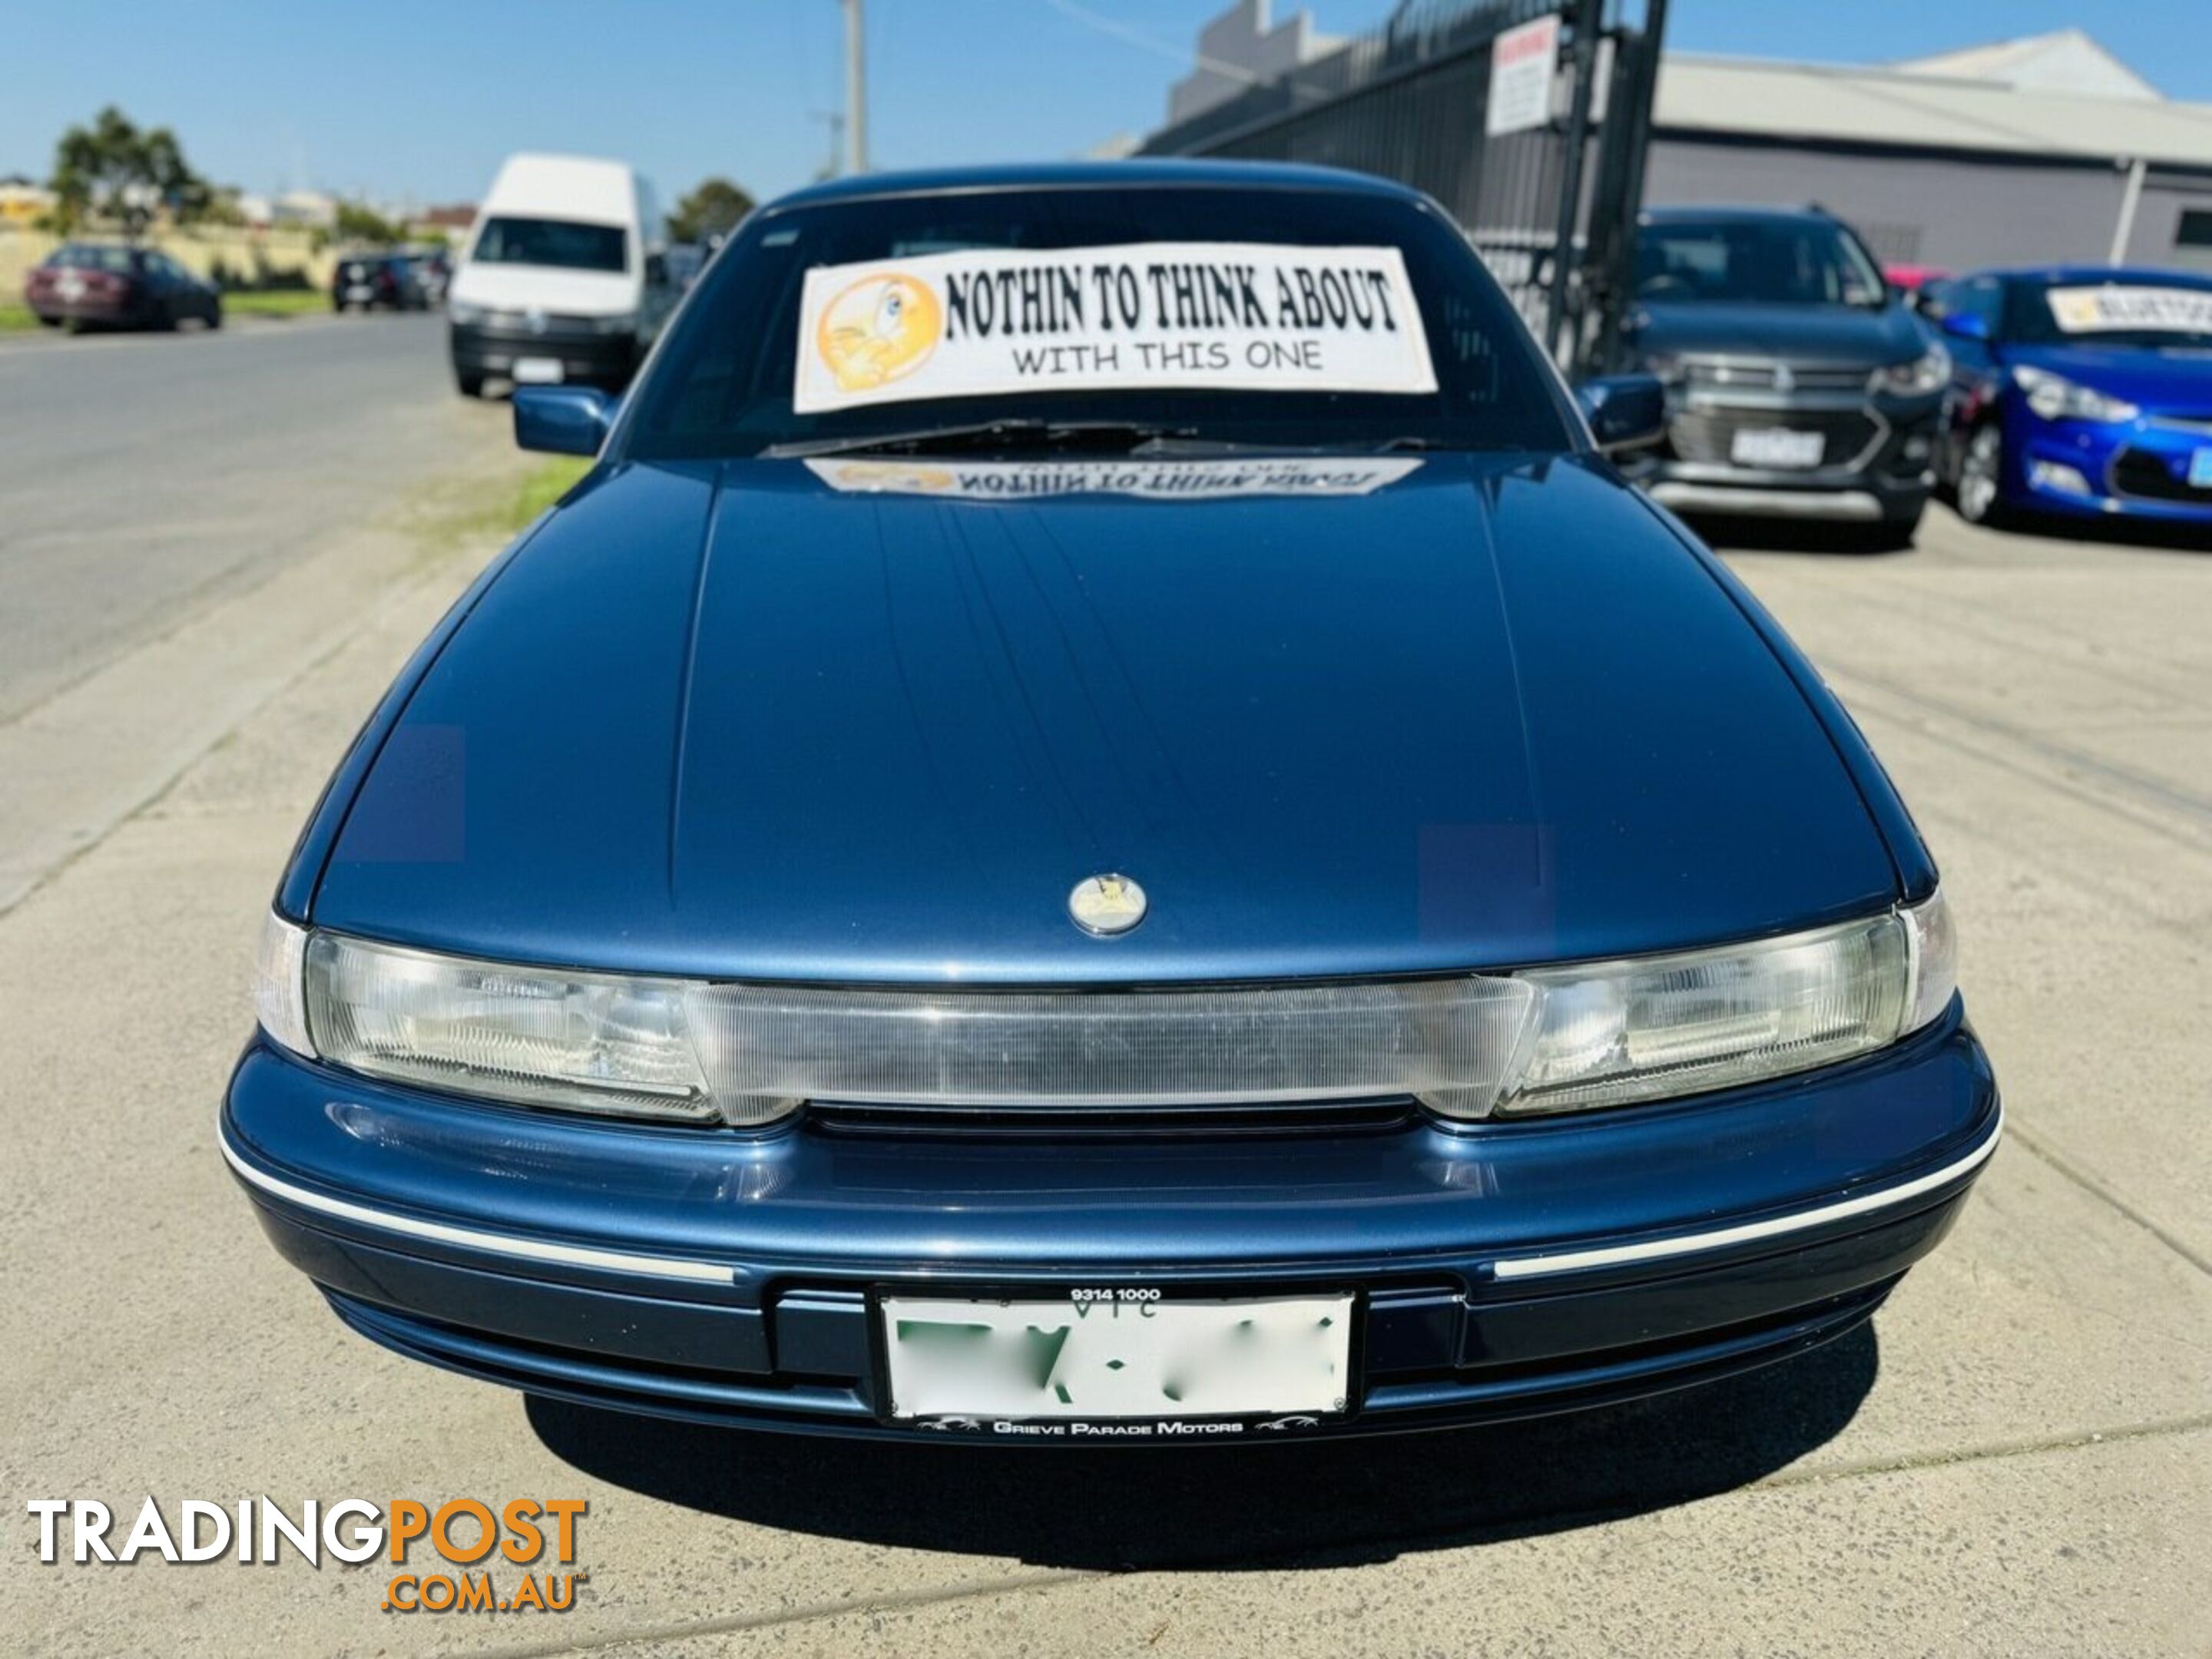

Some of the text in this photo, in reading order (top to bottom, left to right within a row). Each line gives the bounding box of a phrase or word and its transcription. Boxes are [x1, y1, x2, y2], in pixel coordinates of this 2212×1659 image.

[945, 263, 1396, 339] NOTHIN TO THINK ABOUT
[1012, 339, 1324, 374] WITH THIS ONE
[1071, 1288, 1161, 1300] 9314 1000
[994, 1422, 1243, 1435] GRIEVE PARADE MOTORS
